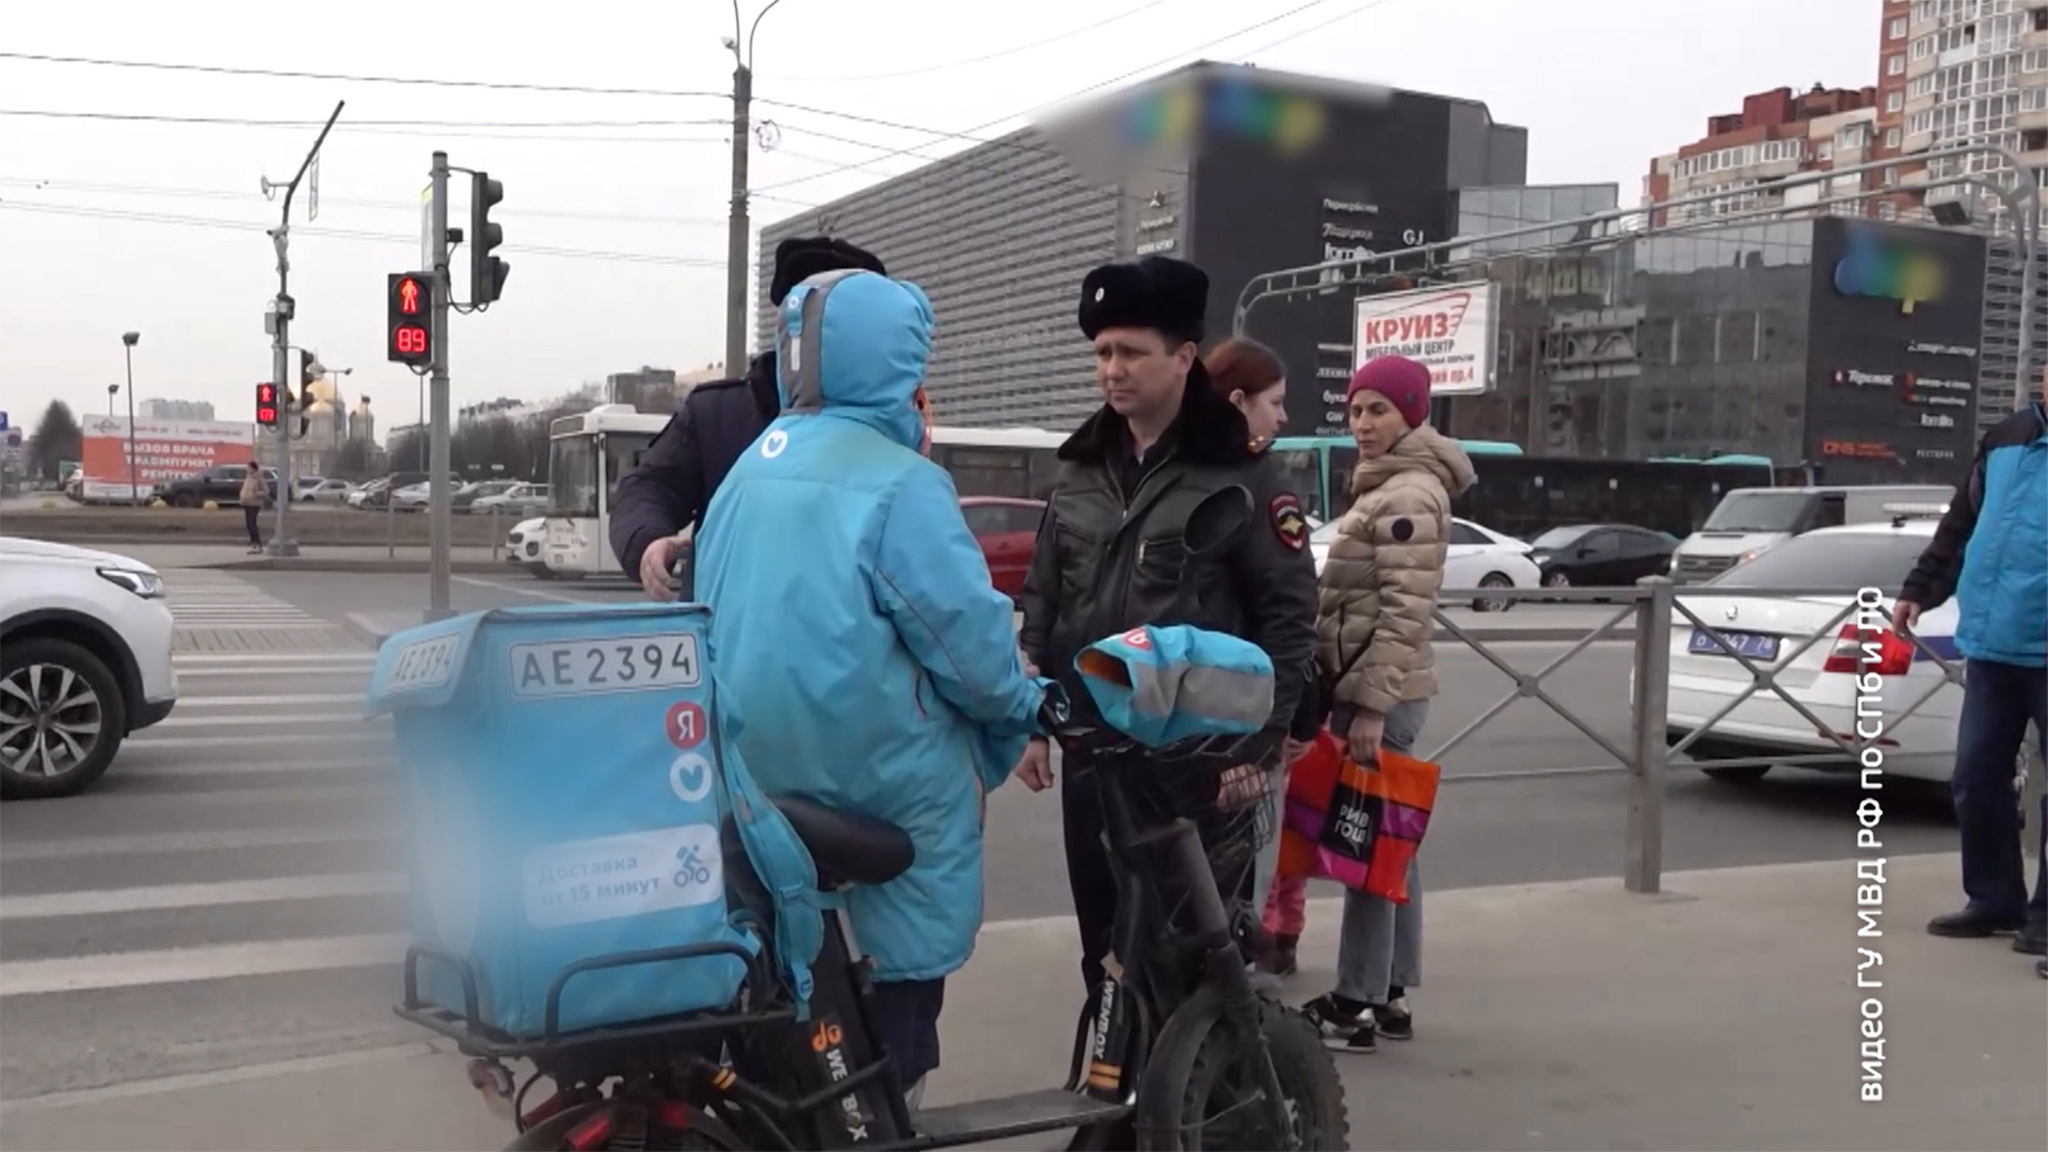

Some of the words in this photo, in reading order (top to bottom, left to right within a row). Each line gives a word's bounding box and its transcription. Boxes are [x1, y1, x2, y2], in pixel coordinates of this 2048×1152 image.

[1403, 228, 1424, 246] GJ
[398, 327, 426, 353] 89
[1366, 312, 1449, 345] КРУИЗ
[1424, 339, 1455, 356] ЦЕНТР
[123, 442, 171, 454] ВЫЗОВ
[172, 445, 215, 456] ВРАЧА
[676, 710, 695, 741] Я
[1339, 804, 1370, 828] РИВ
[1334, 820, 1367, 844] ГОШ
[538, 856, 639, 886] Доставка
[569, 884, 591, 902] 15
[596, 877, 661, 898] минут
[826, 1048, 868, 1142] WEBOX
